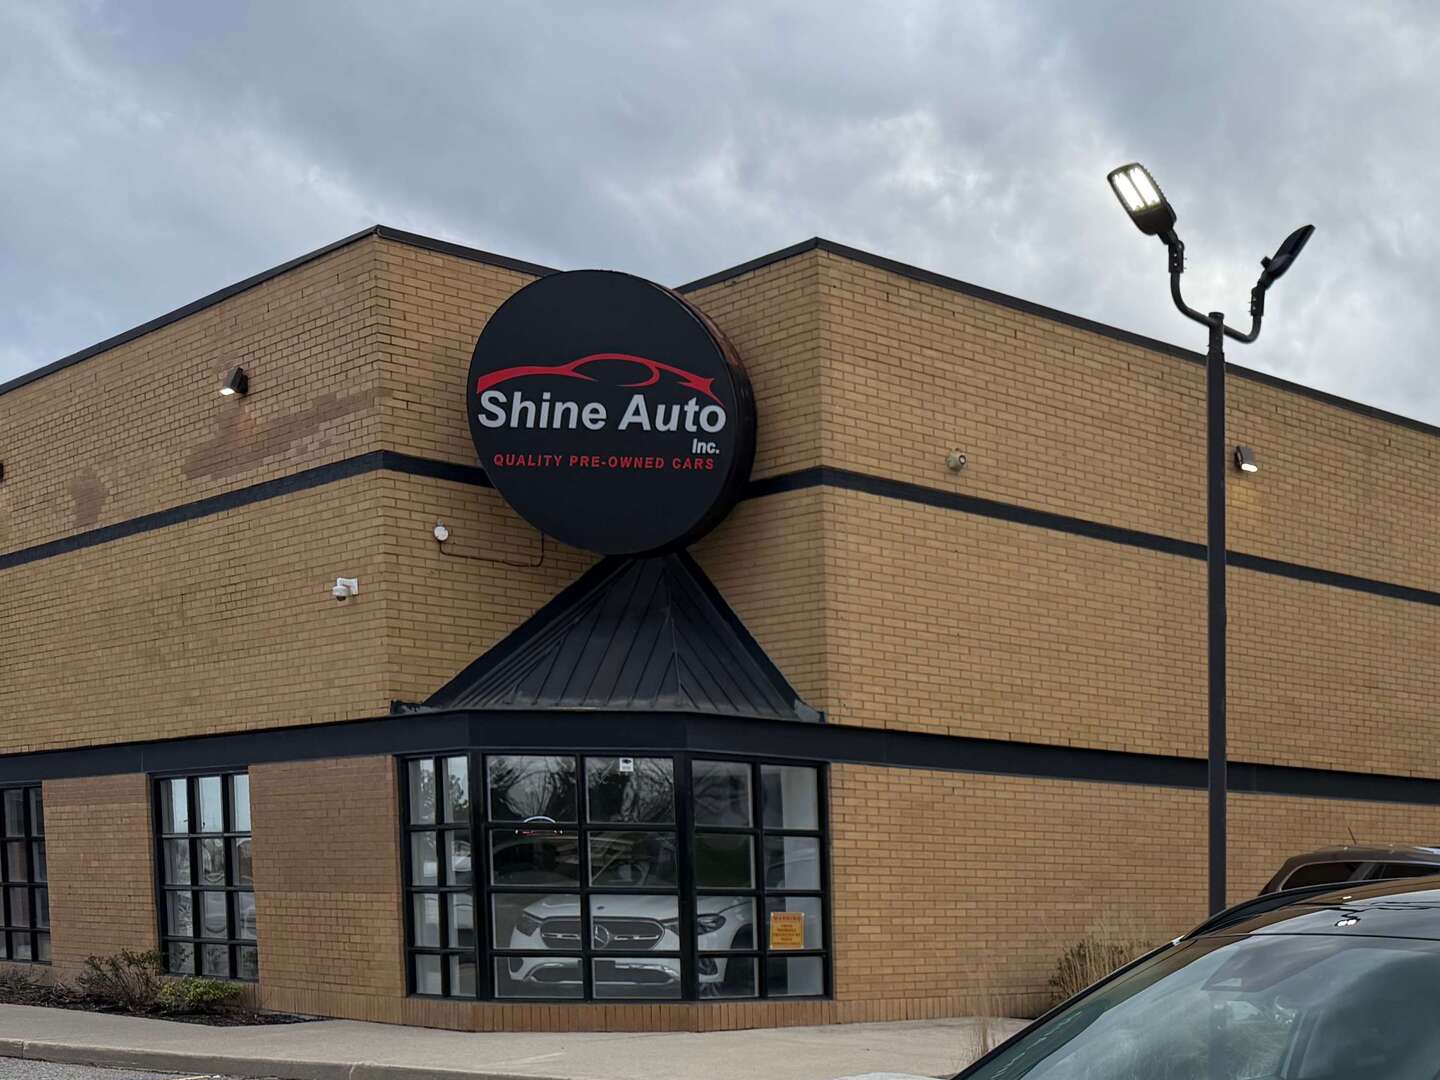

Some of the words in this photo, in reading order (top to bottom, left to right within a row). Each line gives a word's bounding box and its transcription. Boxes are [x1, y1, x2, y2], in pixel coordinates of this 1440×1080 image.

[478, 390, 607, 430] Shine
[618, 394, 727, 433] Auto
[691, 438, 720, 454] Inc.
[493, 453, 562, 468] QUALITY
[569, 455, 665, 470] PRE-OWNED
[672, 457, 714, 470] CARS
